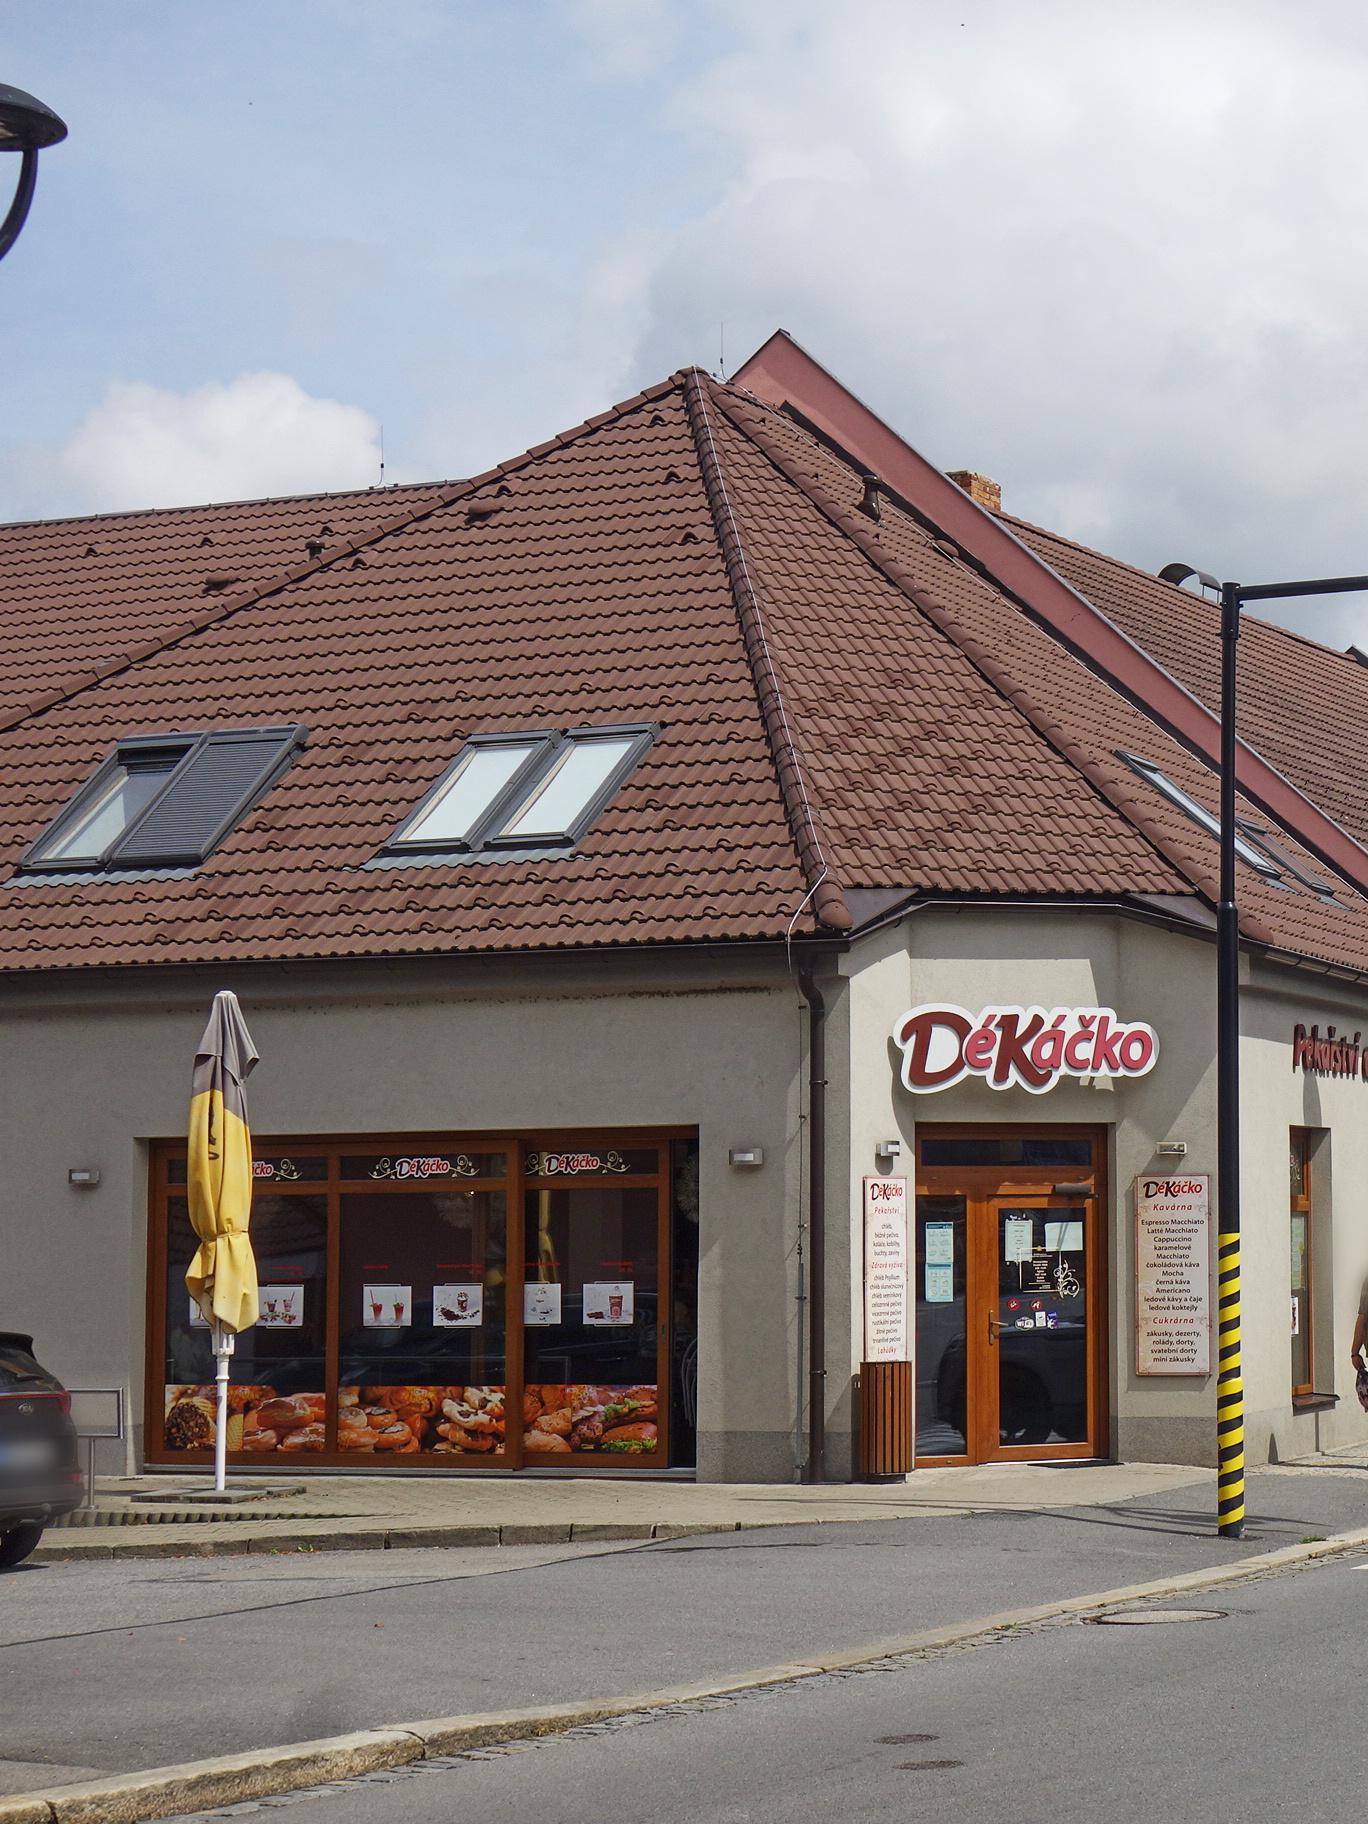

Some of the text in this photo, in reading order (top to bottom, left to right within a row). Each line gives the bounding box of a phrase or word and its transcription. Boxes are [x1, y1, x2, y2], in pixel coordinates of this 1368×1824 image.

[900, 1010, 1153, 1087] DéKáčko
[396, 1159, 450, 1179] DéKáčko
[545, 1155, 600, 1176] DéKáčko
[1143, 1181, 1202, 1198] DéKáčko
[1153, 1203, 1192, 1211] Kavárna
[1171, 1304, 1198, 1312] koktejly
[1152, 1316, 1194, 1324] Cukrárna
[1146, 1330, 1202, 1338] zákusky, dezerty,
